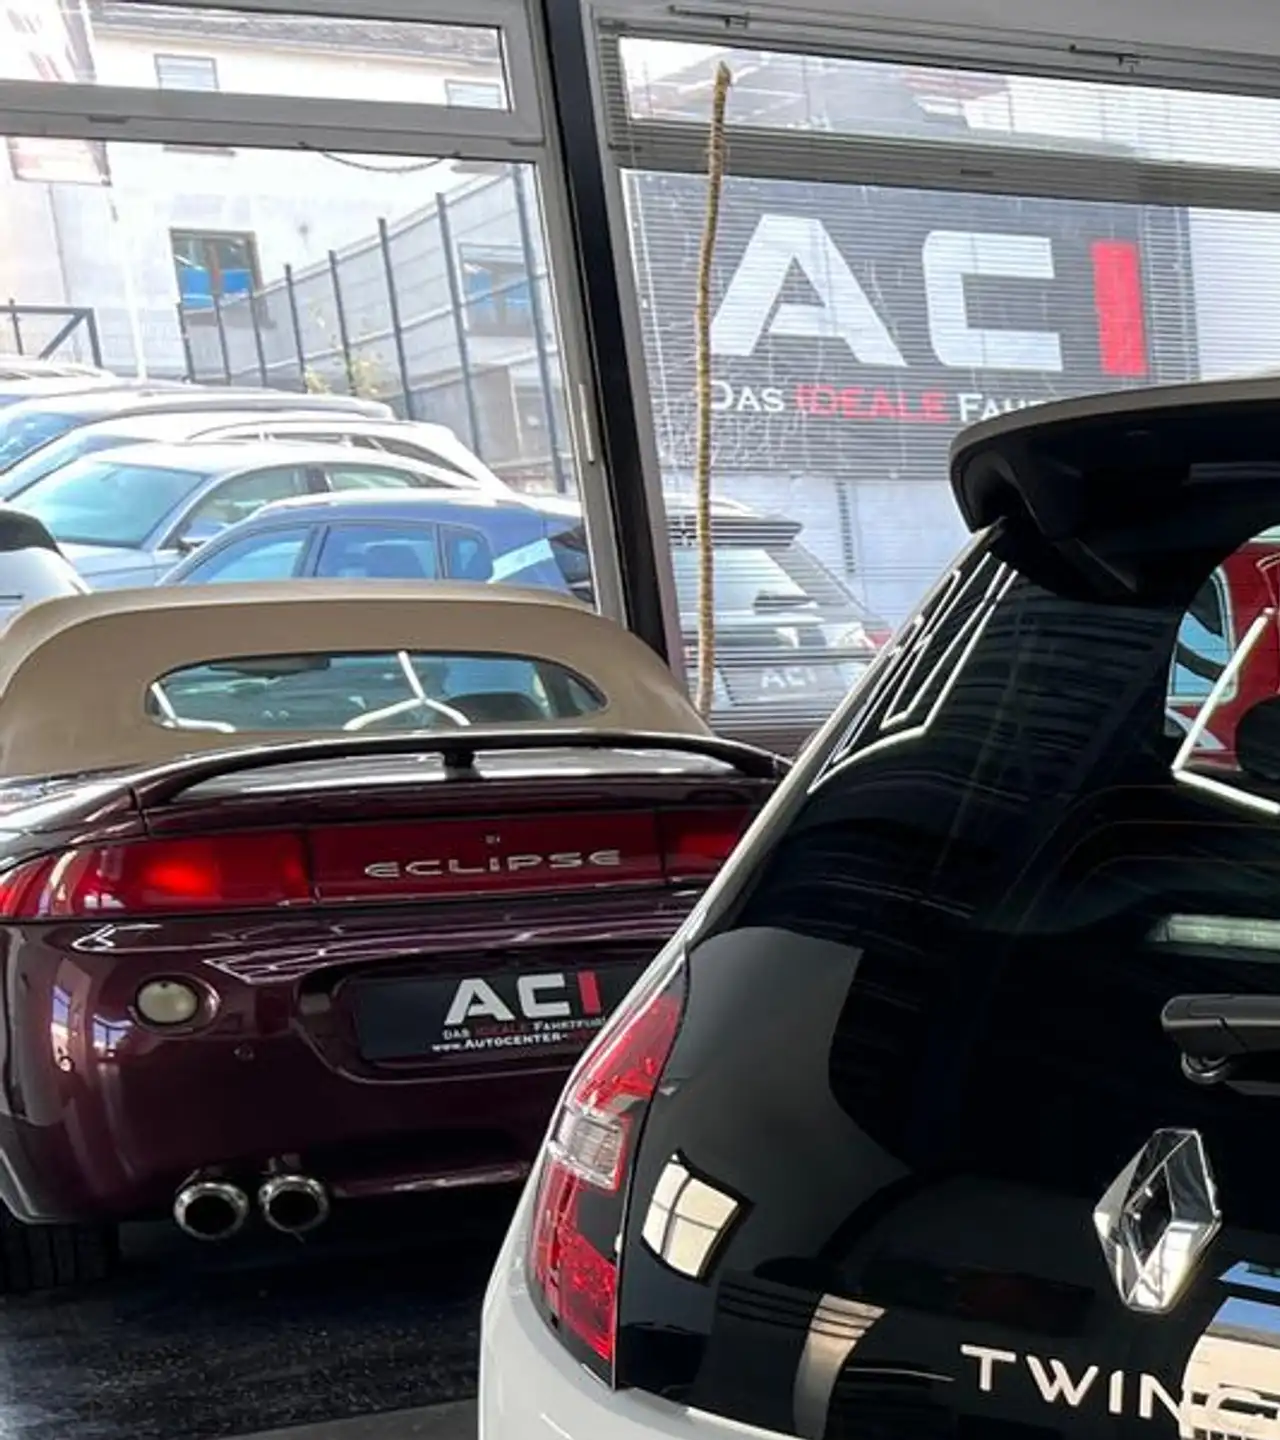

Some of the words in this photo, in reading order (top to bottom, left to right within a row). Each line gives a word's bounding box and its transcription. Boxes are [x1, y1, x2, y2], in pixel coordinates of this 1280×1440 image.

[709, 213, 1148, 376] ACI
[796, 383, 950, 423] IDEALE
[364, 850, 620, 877] ECLIPSE
[444, 969, 602, 1025] ACI
